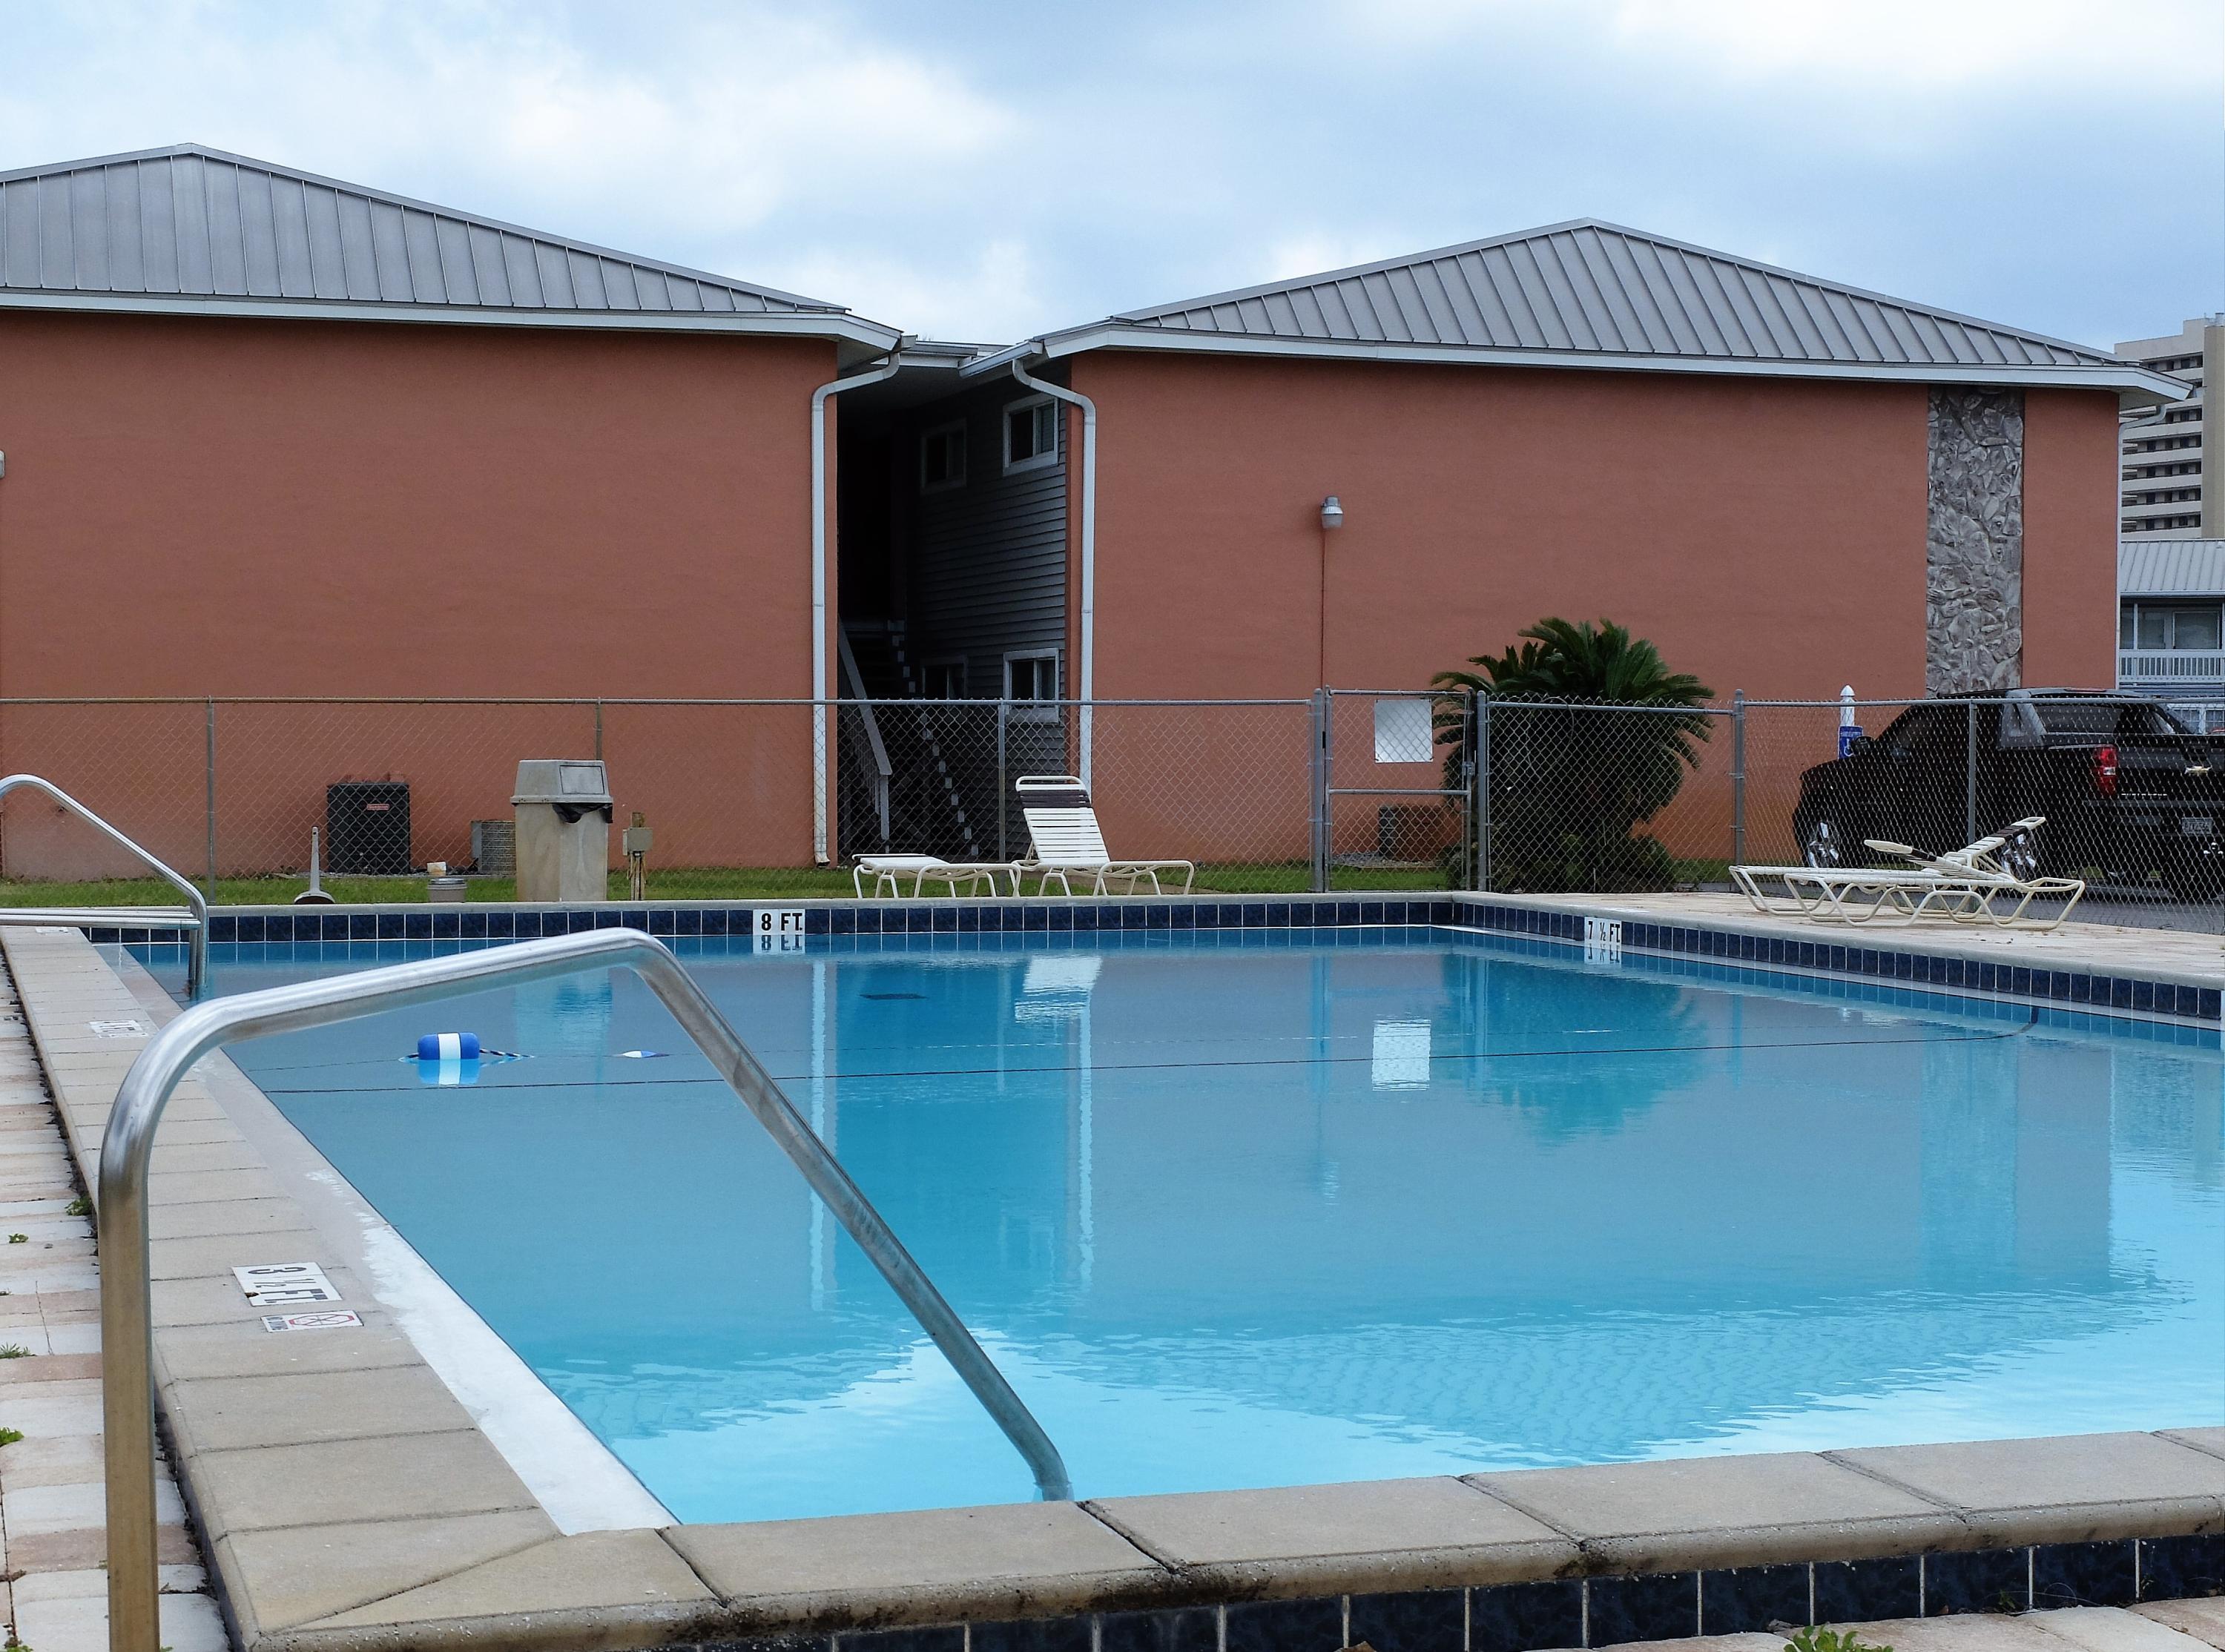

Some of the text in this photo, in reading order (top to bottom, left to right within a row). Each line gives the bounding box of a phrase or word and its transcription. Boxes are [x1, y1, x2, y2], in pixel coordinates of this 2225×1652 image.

[761, 913, 802, 931] 8 FT.
[1588, 921, 1593, 939] 7
[1609, 923, 1621, 942] FT.
[248, 1266, 307, 1275] 3
